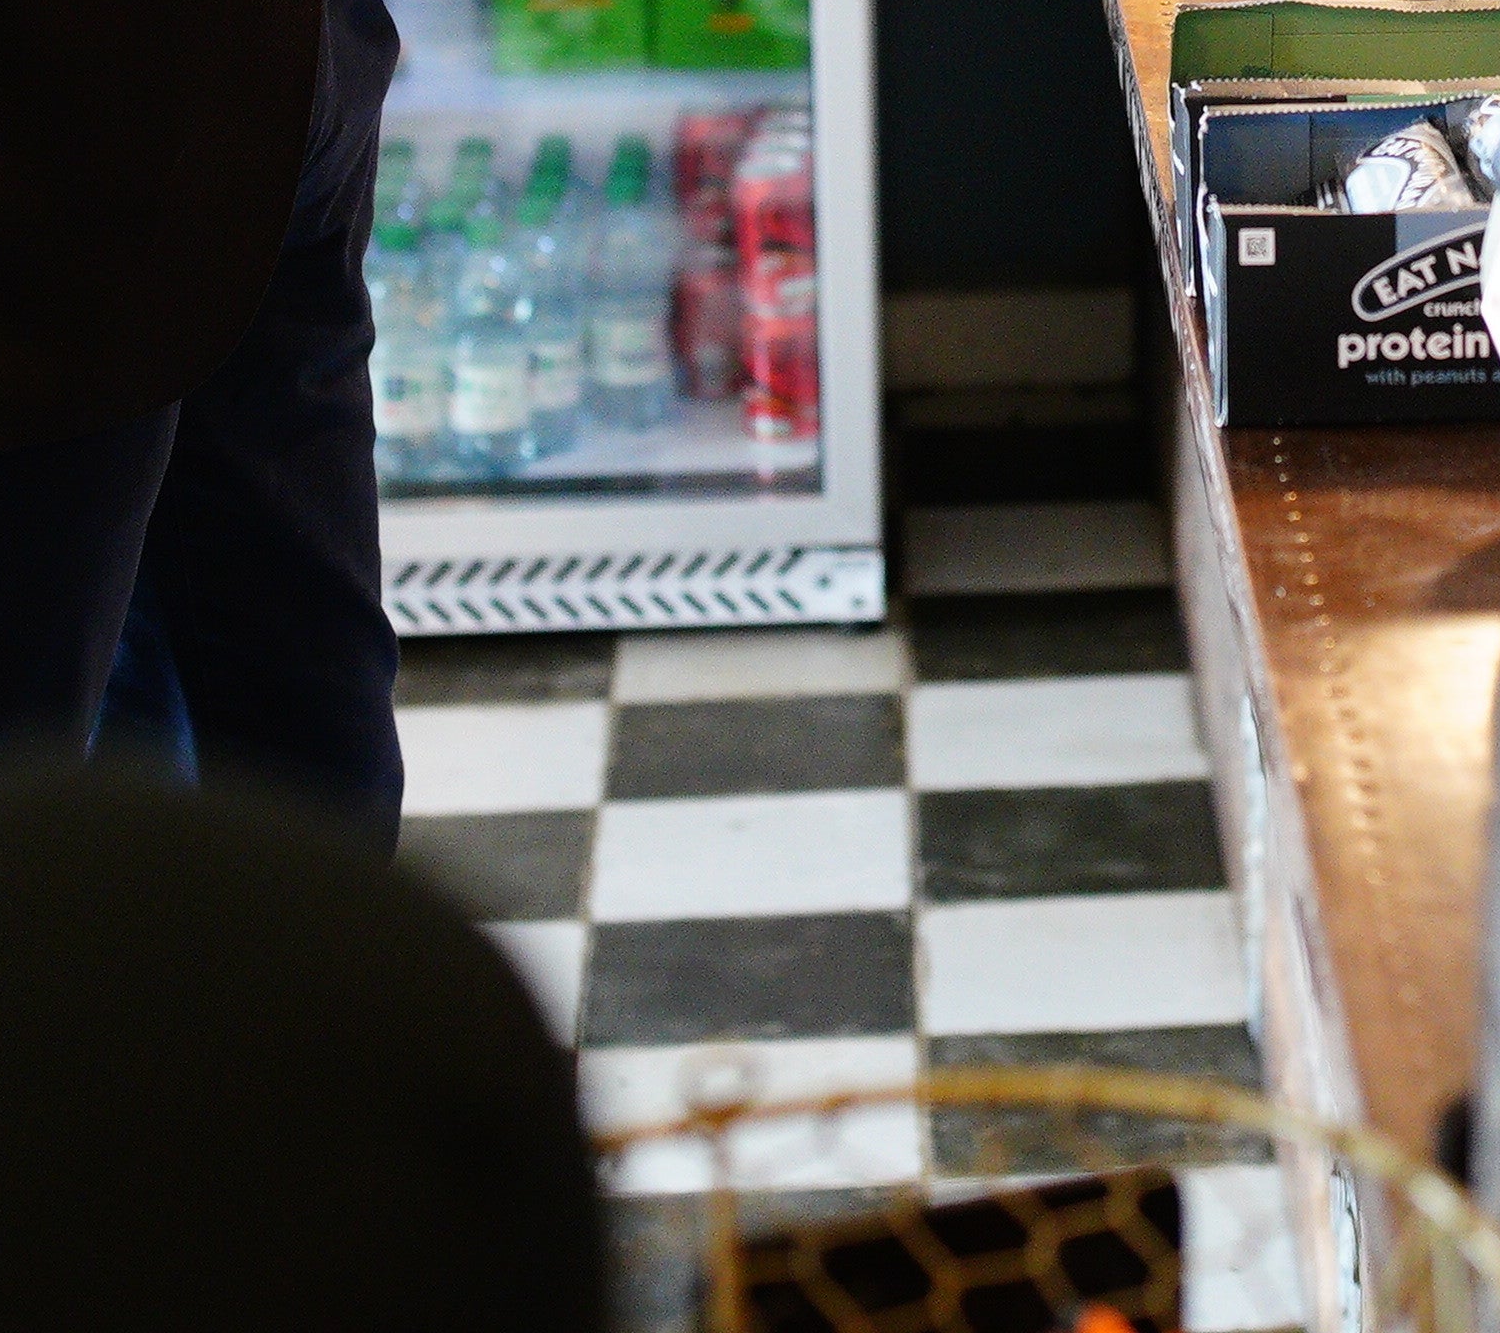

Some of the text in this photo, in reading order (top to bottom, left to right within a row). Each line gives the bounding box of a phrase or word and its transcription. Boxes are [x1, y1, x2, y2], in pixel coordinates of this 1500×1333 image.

[1372, 241, 1481, 307] EAT N
[1336, 324, 1490, 369] protein
[1365, 369, 1405, 386] with
[1411, 368, 1487, 387] peanuts
